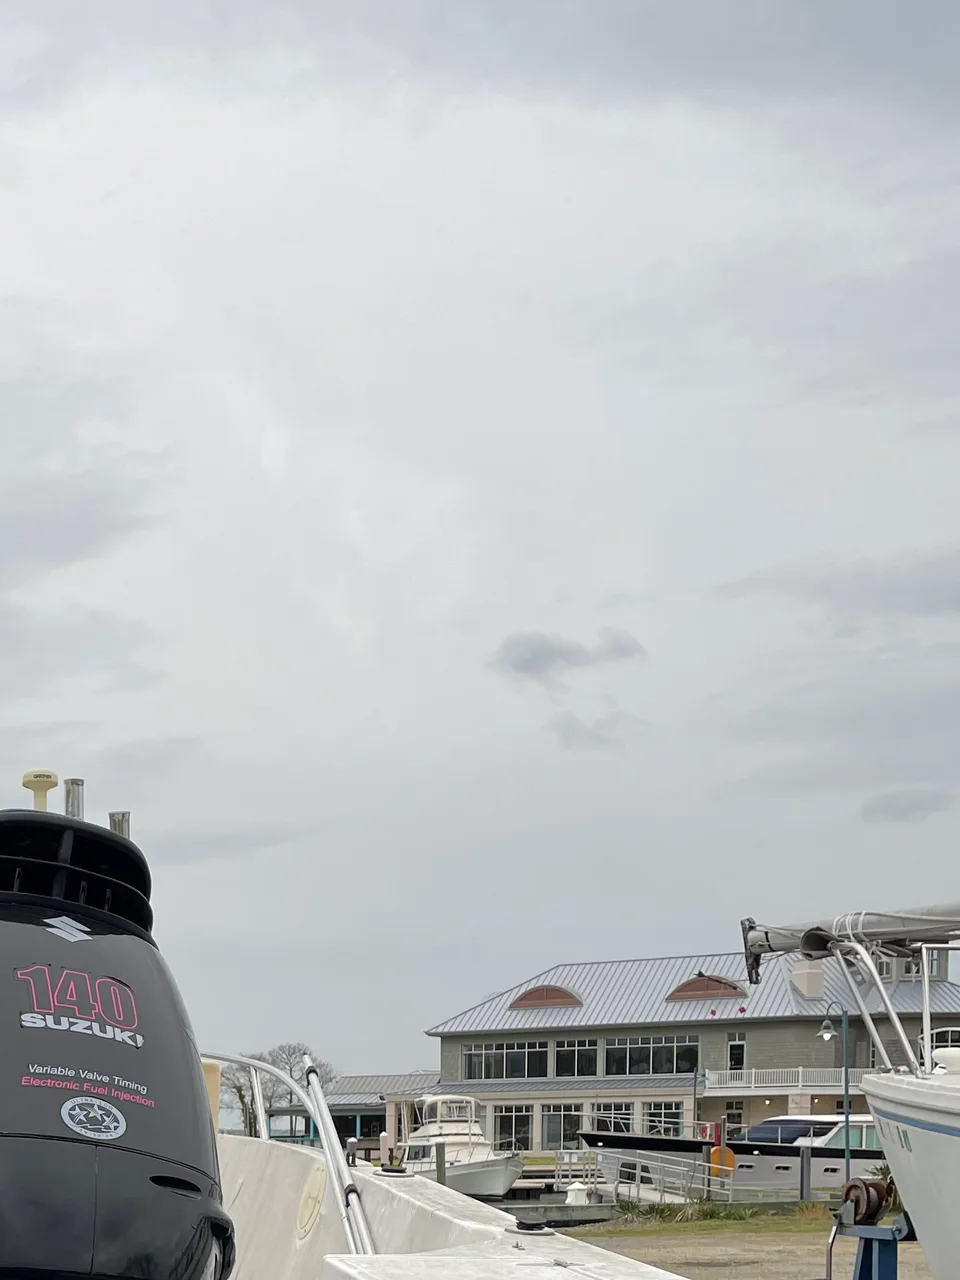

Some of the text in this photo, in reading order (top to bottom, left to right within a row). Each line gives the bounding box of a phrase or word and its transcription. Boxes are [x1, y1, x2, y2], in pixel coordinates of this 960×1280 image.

[16, 965, 138, 1029] 140
[21, 1076, 156, 1108] Electronic Fuel Injection
[28, 1063, 148, 1095] Variable Valve Timing
